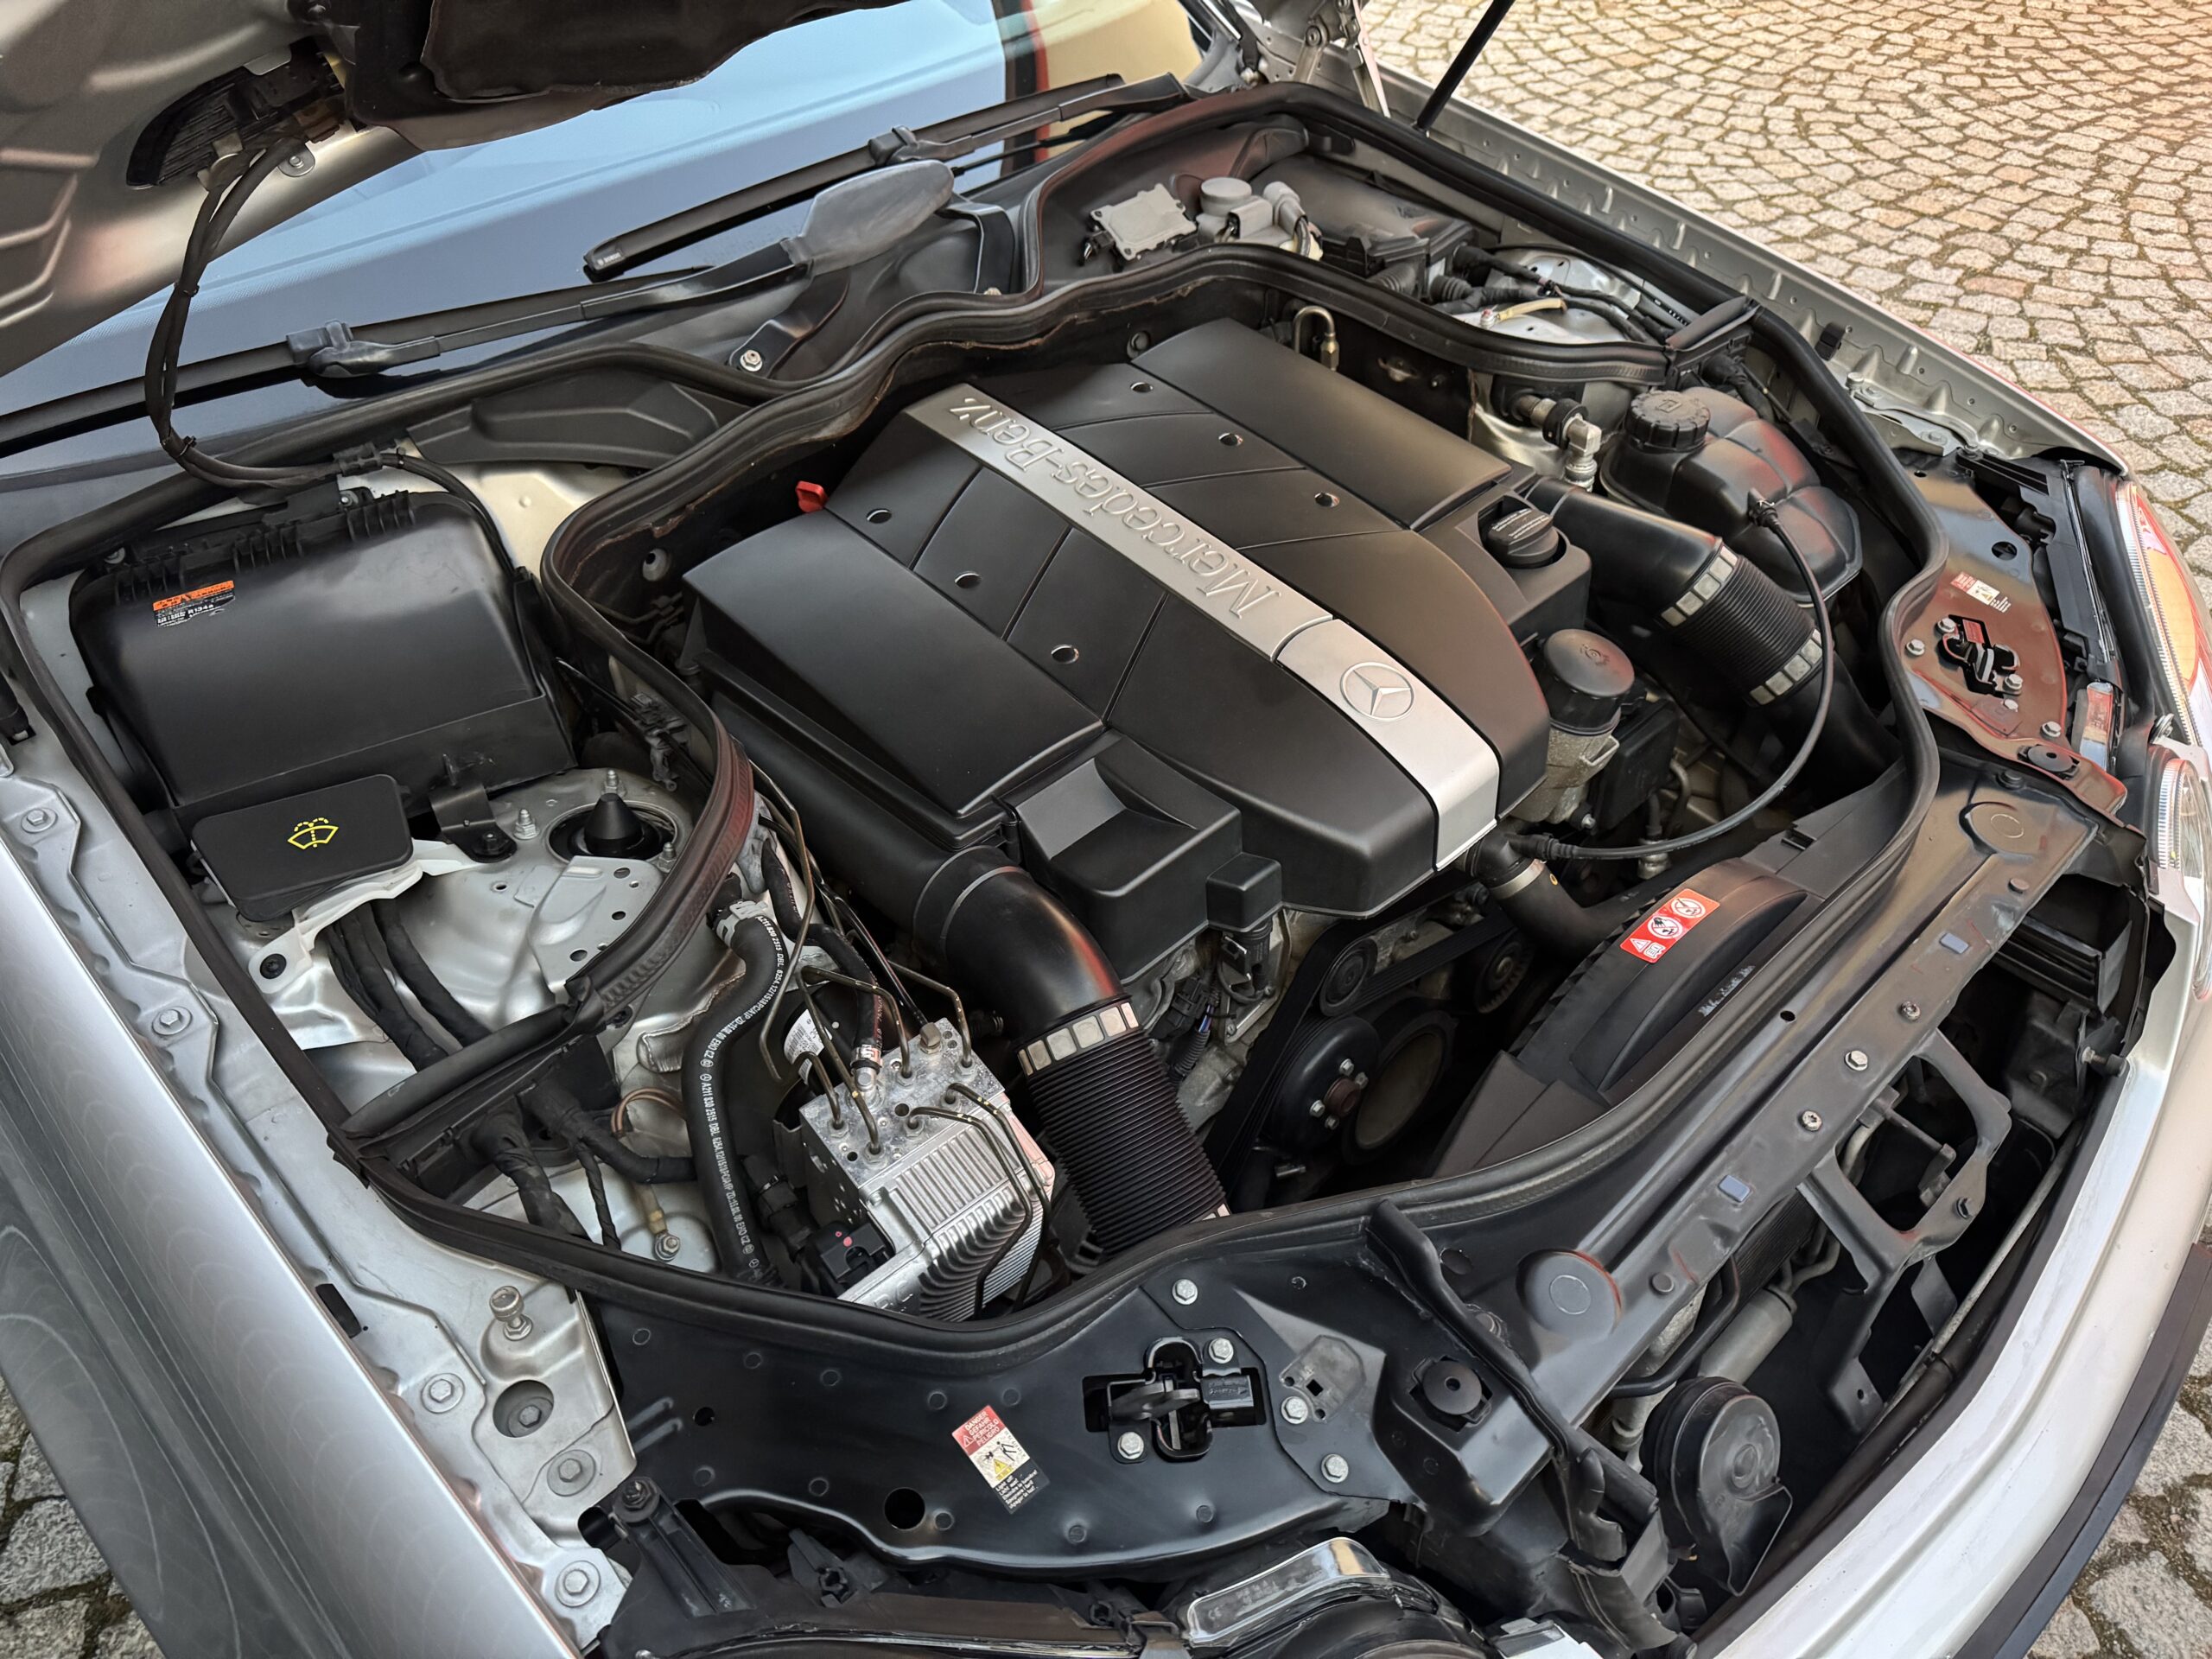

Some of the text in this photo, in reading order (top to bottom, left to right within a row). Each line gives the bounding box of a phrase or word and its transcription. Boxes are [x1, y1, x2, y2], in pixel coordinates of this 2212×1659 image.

[949, 397, 1282, 620] Mercedes-Benz
[772, 938, 783, 951] 2515
[701, 1082, 714, 1096] A211
[703, 1096, 715, 1108] 830
[705, 1108, 718, 1122] 2515
[709, 1122, 721, 1137] DBL
[964, 1410, 988, 1431] DANGER
[969, 1417, 991, 1436] GEFAHR
[972, 1418, 1000, 1441] PERICOLO
[976, 1426, 1000, 1446] PELIGRO
